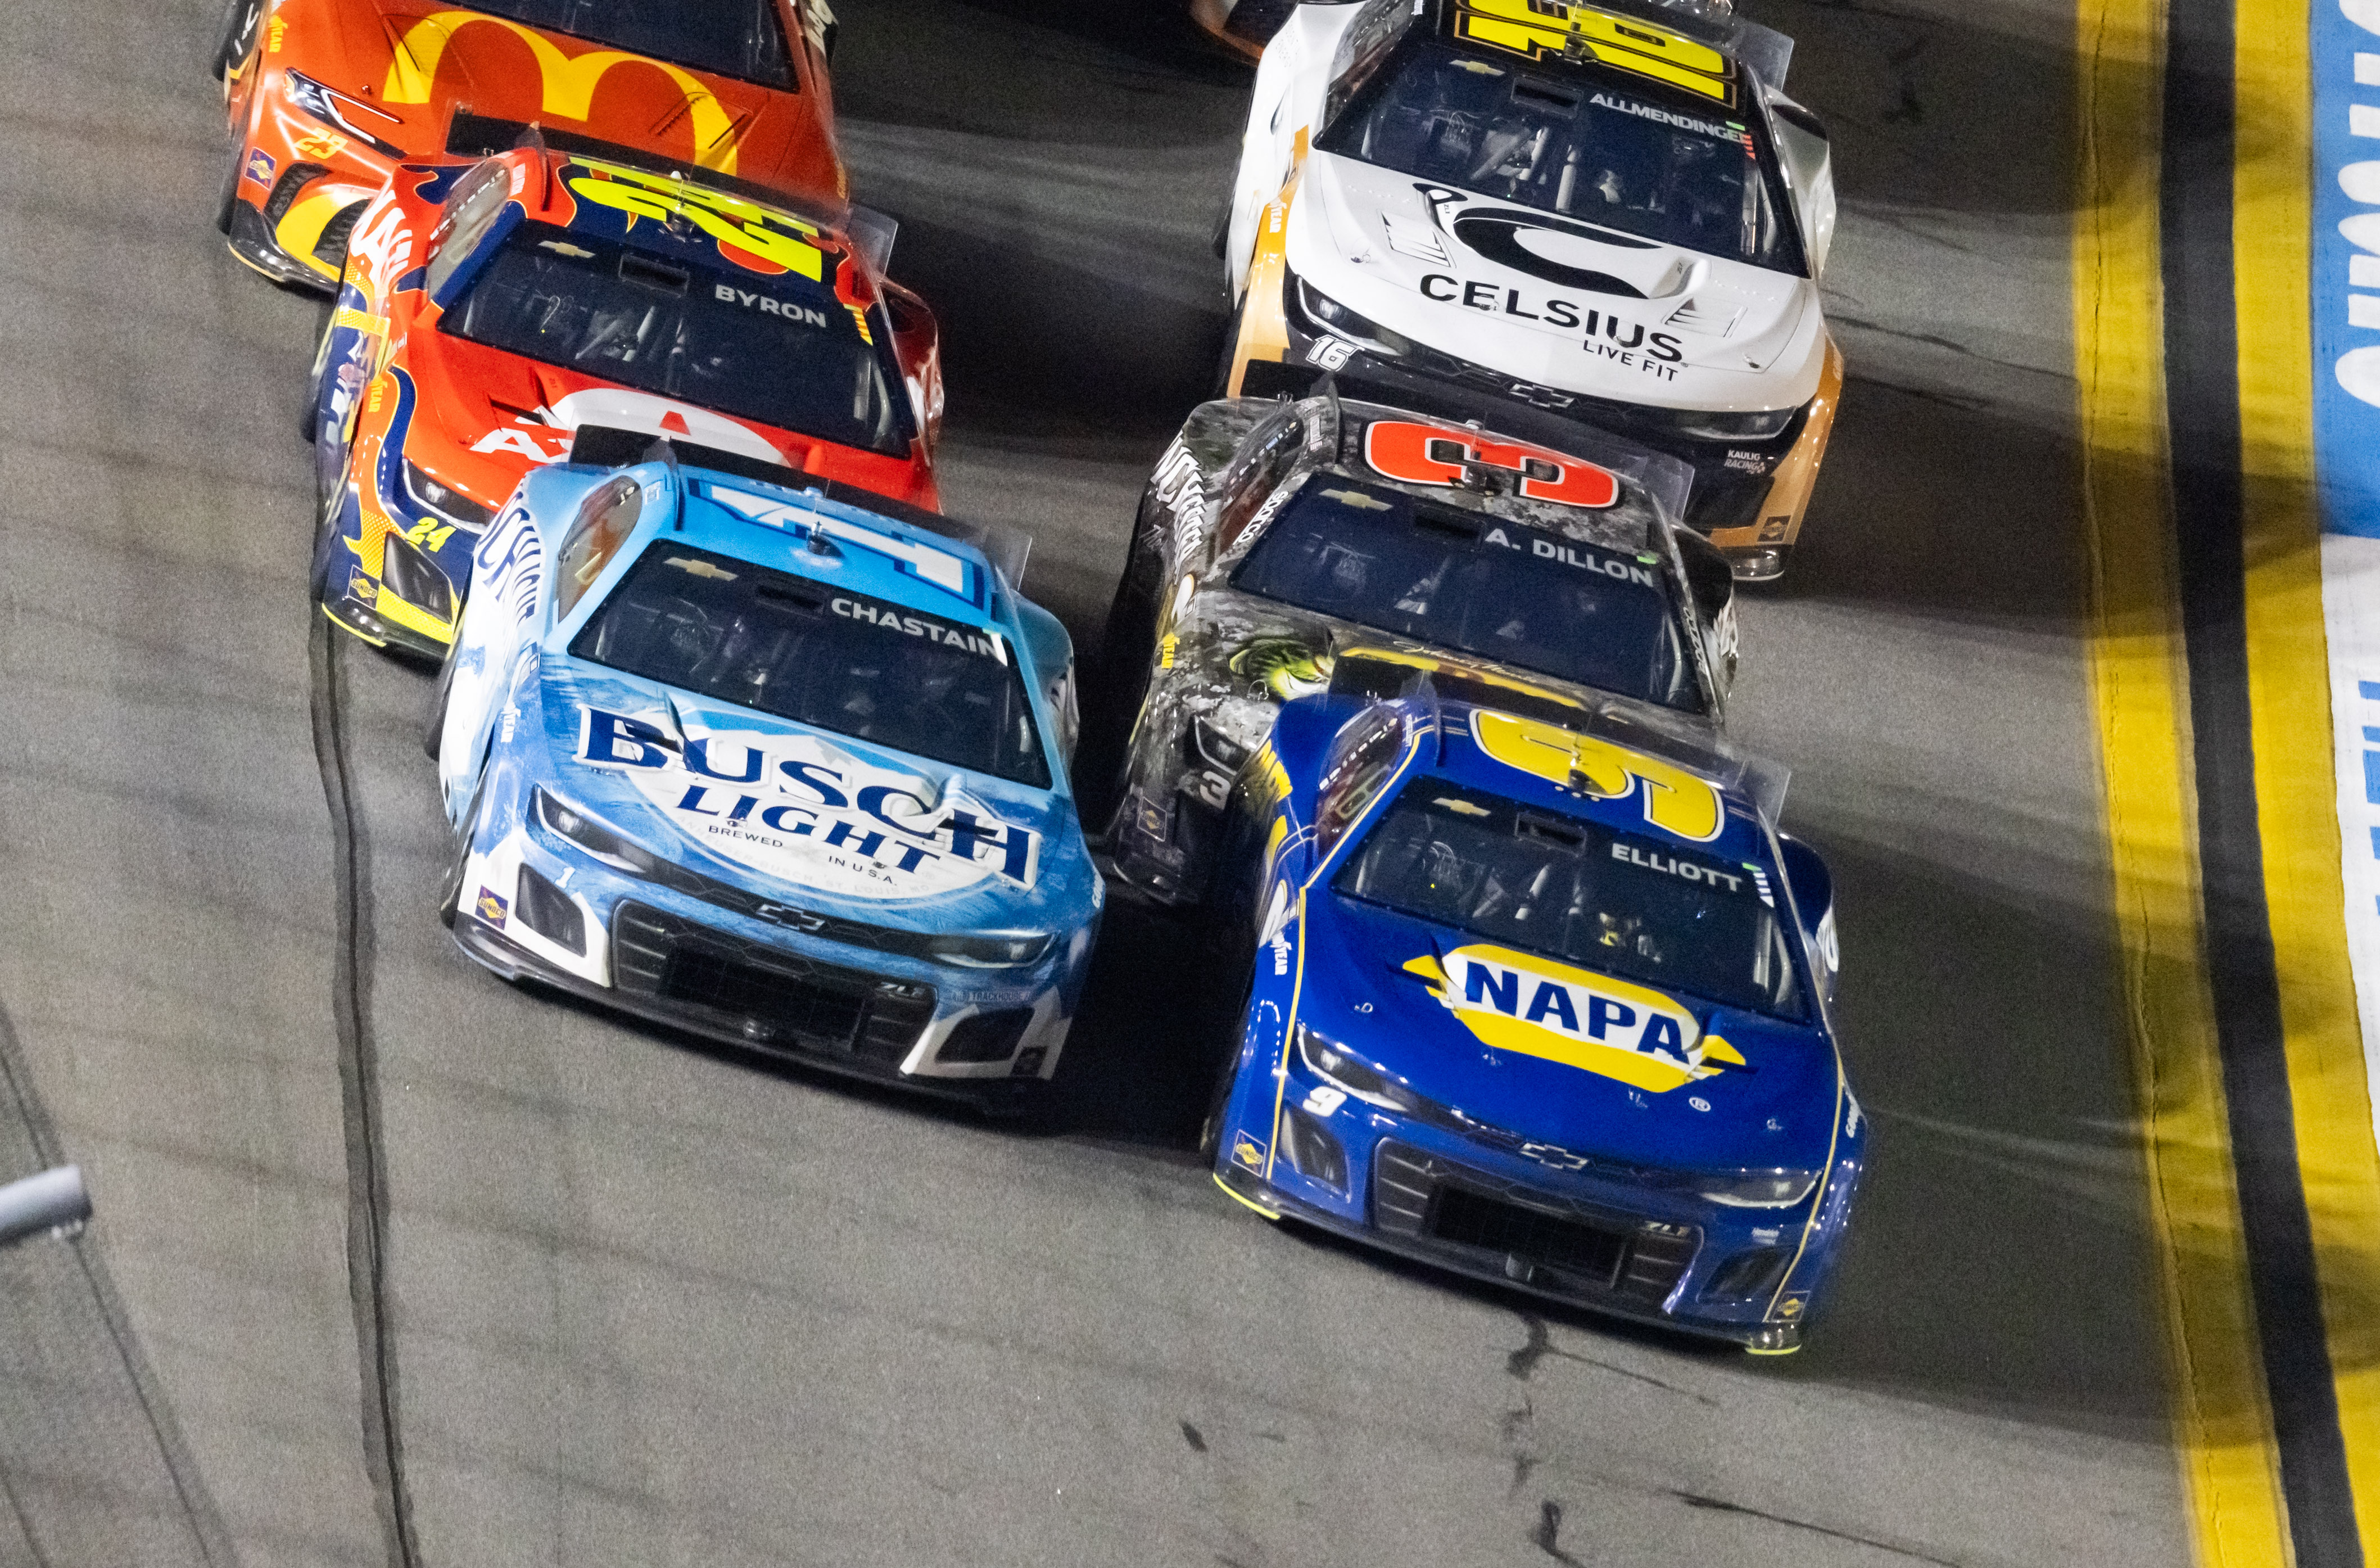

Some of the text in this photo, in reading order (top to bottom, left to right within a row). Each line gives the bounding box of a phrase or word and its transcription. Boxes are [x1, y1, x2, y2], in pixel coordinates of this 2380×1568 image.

[295, 127, 349, 159] 23
[715, 284, 826, 328] BYRON
[1420, 274, 1683, 363] CELSIUS
[1305, 334, 1358, 372] 16
[1583, 340, 1678, 382] LIVE FIT
[1365, 421, 1619, 508] 3
[1724, 458, 1759, 470] RACING
[1727, 450, 1761, 461] KAULIG
[405, 516, 457, 553] 24
[1234, 491, 1289, 545] sparco
[1485, 528, 1654, 588] A. DILLON
[351, 580, 378, 598] SUNOCO
[831, 598, 999, 659] CHASTAIN
[577, 705, 1040, 889] BUSCH
[1199, 771, 1232, 810] 3
[676, 785, 940, 874] LIGHT
[708, 825, 783, 848] BREWED
[829, 855, 845, 867] IN
[553, 867, 575, 889] 1
[1612, 843, 1742, 893] ELLIOTT
[479, 899, 505, 919] SUNOCO
[1465, 960, 1690, 1066] NAPA
[1302, 1086, 1347, 1118] 9
[1236, 1145, 1263, 1164] SUNOCO
